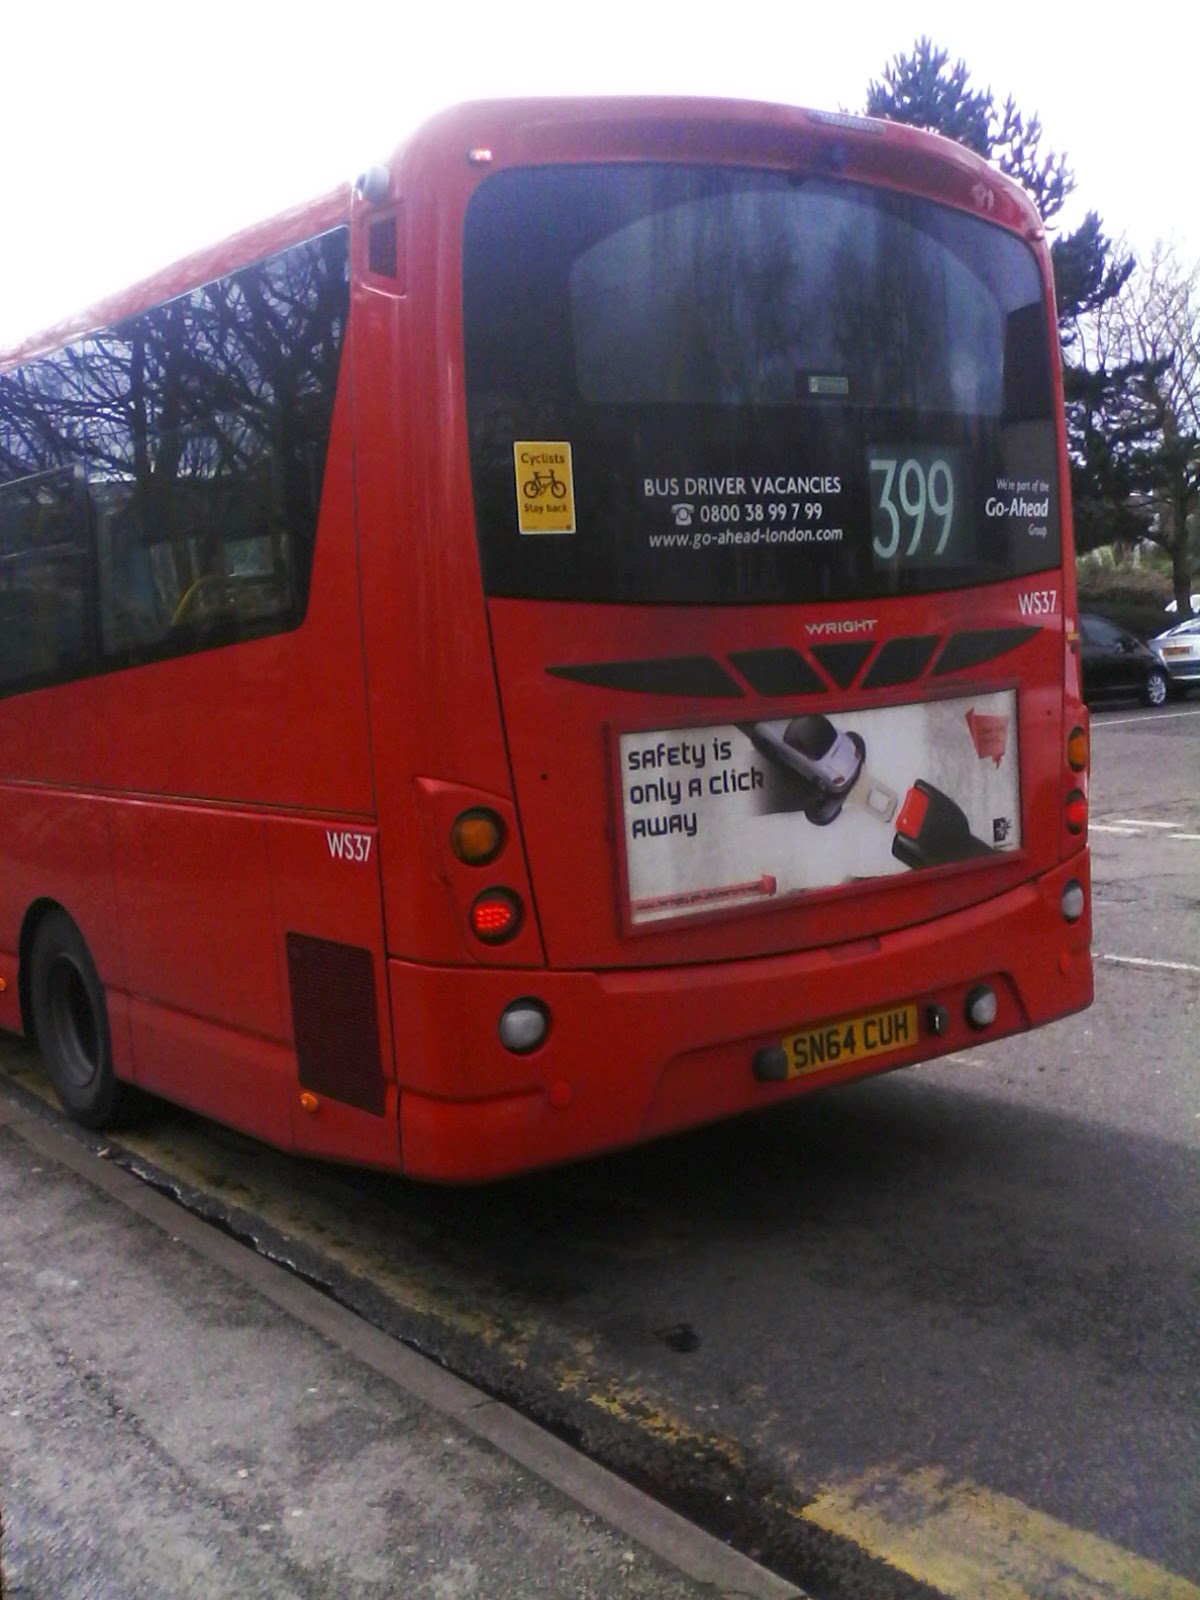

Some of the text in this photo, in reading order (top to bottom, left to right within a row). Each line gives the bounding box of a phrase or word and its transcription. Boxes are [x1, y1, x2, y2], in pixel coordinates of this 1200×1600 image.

[521, 453, 565, 466] Cyclists
[644, 476, 842, 496] BUS DRIVER VACANCIES
[524, 503, 568, 513] Stay back
[700, 502, 823, 522] 0800 38 99 7 99
[870, 459, 954, 559] 399
[985, 497, 1049, 517] Go-Ahead
[649, 527, 844, 549] www.go-ahead-london.com
[1018, 591, 1057, 615] WS37
[804, 619, 878, 635] WRIGHT
[713, 737, 732, 761] is
[630, 777, 681, 805] only
[709, 767, 764, 795] click
[326, 831, 372, 862] WS37
[793, 1011, 909, 1070] SN64 CUH
